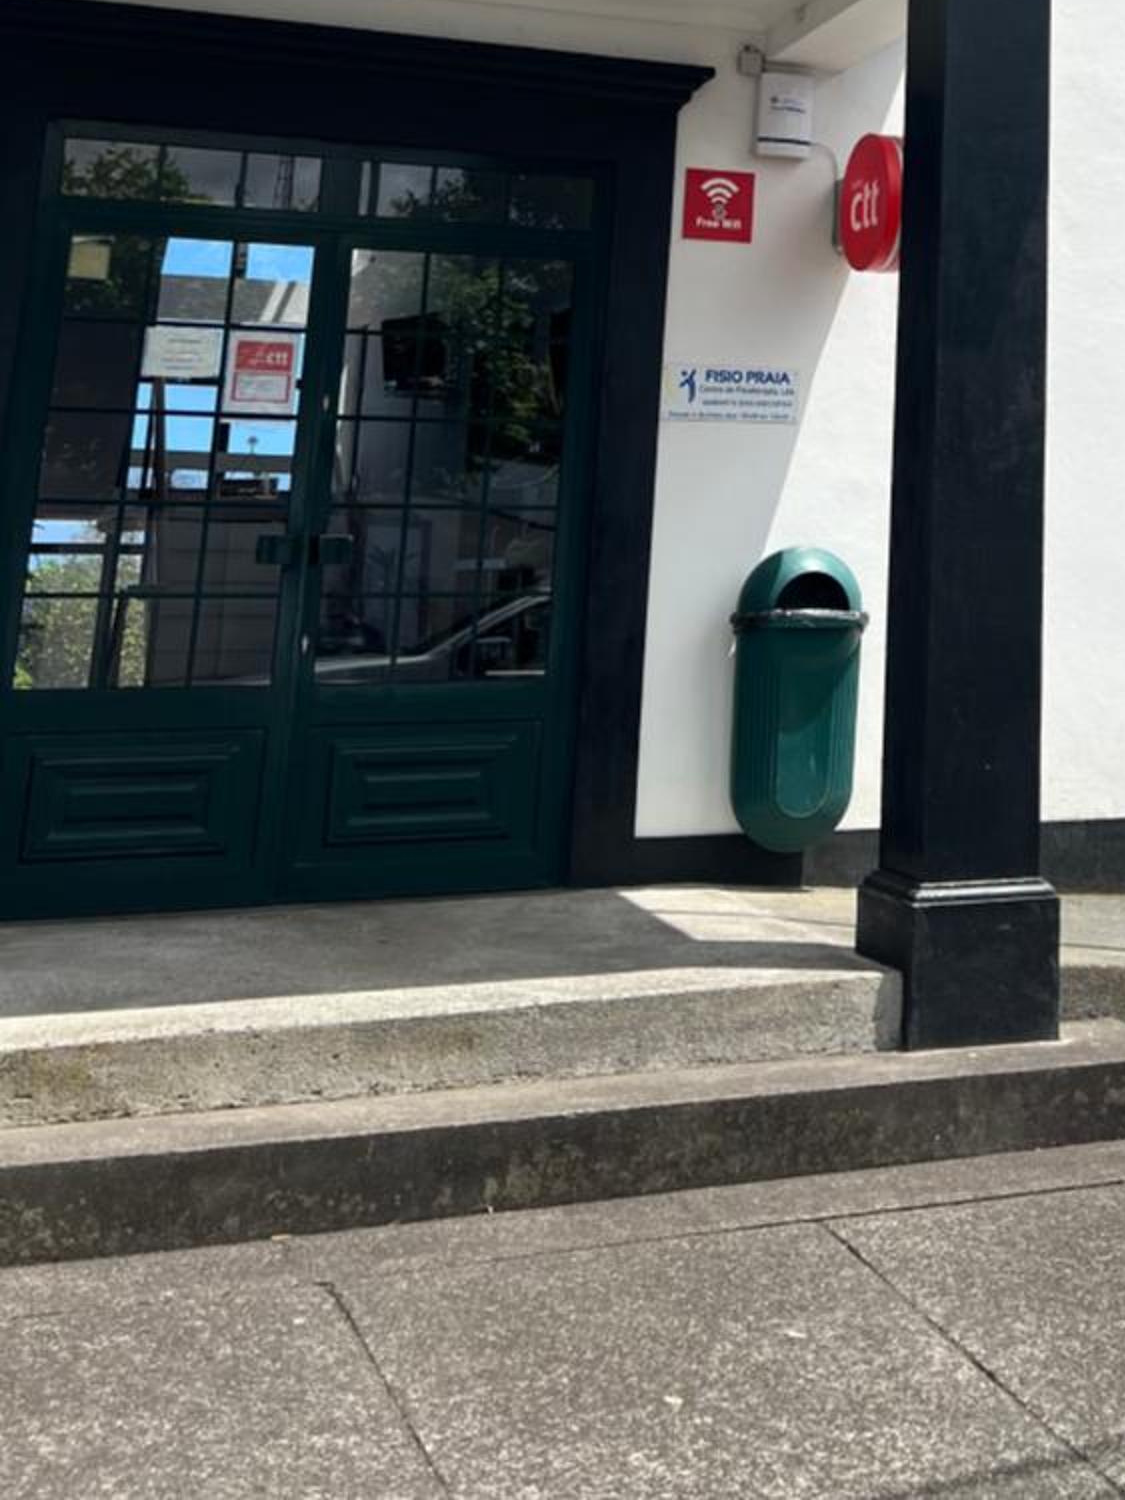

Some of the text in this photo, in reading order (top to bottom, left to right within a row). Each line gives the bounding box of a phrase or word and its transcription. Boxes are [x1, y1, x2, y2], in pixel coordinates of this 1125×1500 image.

[850, 180, 879, 231] ctt
[704, 369, 791, 385] FISIO PRAIA
